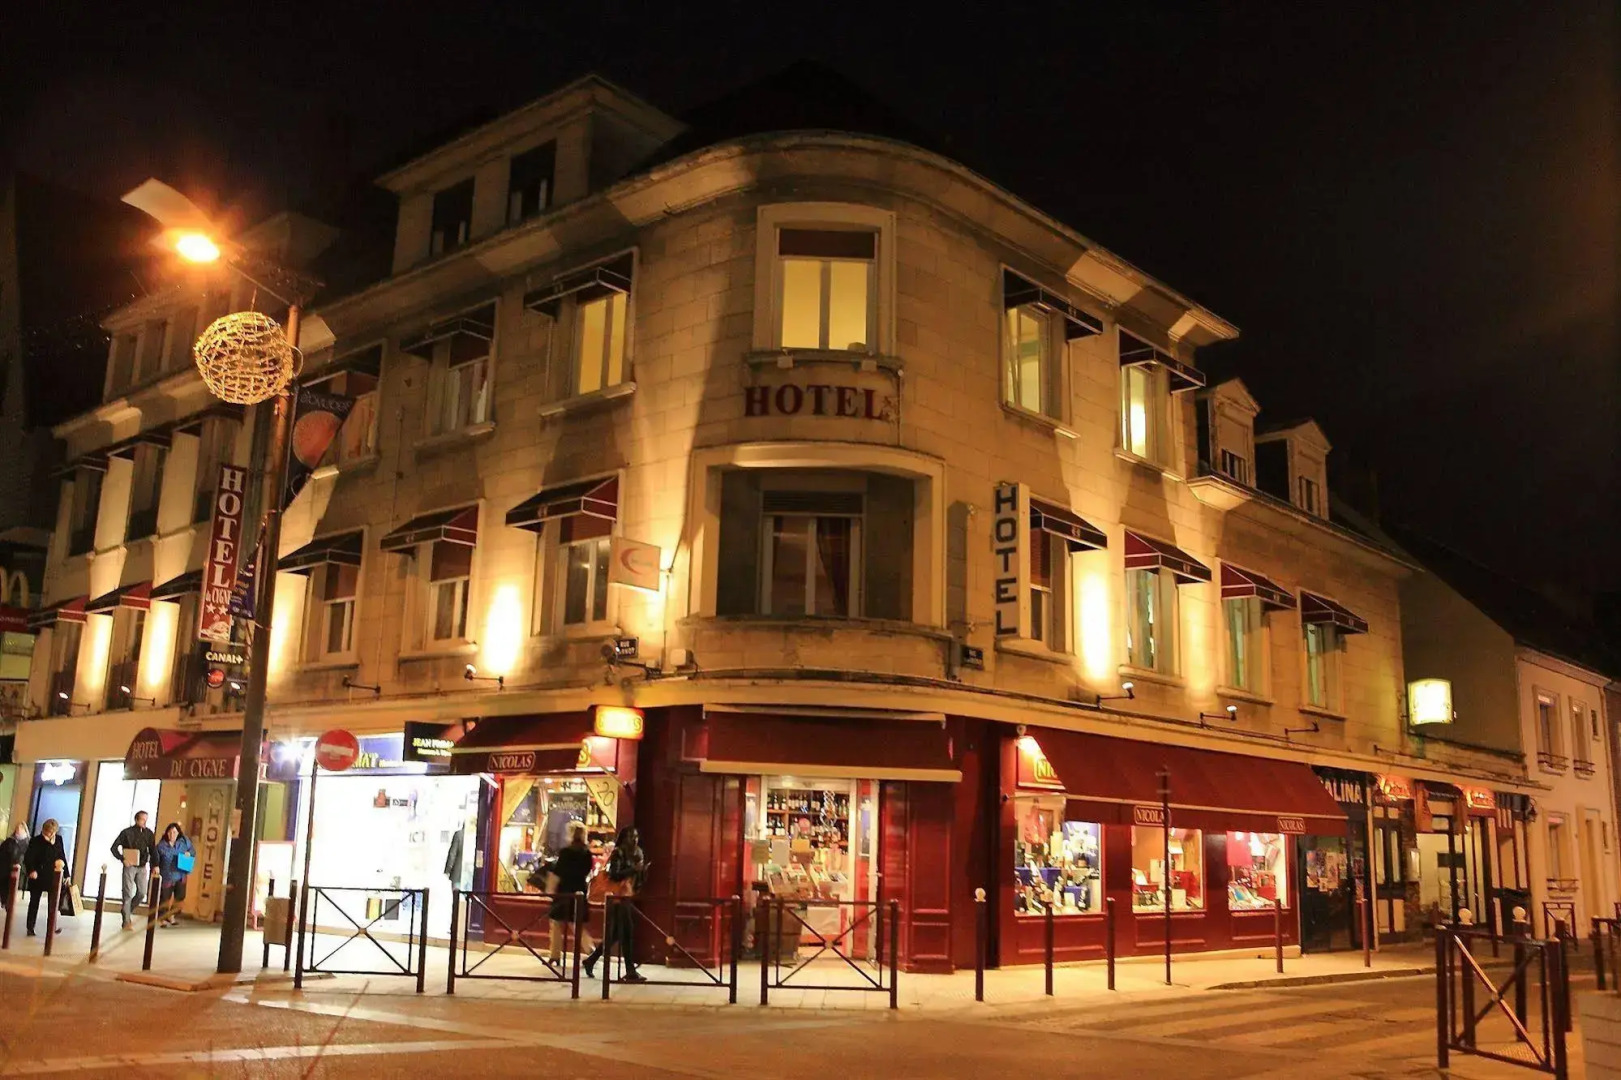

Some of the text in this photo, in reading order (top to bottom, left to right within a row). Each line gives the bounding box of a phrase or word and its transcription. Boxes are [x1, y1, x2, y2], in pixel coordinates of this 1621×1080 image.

[744, 384, 883, 420] HOTEL
[212, 467, 244, 589] HOTEL
[995, 486, 1017, 636] HOTEL
[205, 651, 244, 664] CANAL+
[132, 741, 159, 759] HOTEL
[170, 759, 227, 777] DU CYGNE
[491, 754, 533, 769] NICOLAS
[1318, 777, 1364, 804] ALINA
[1136, 809, 1166, 823] NICOLA
[201, 808, 219, 898] HOTEL
